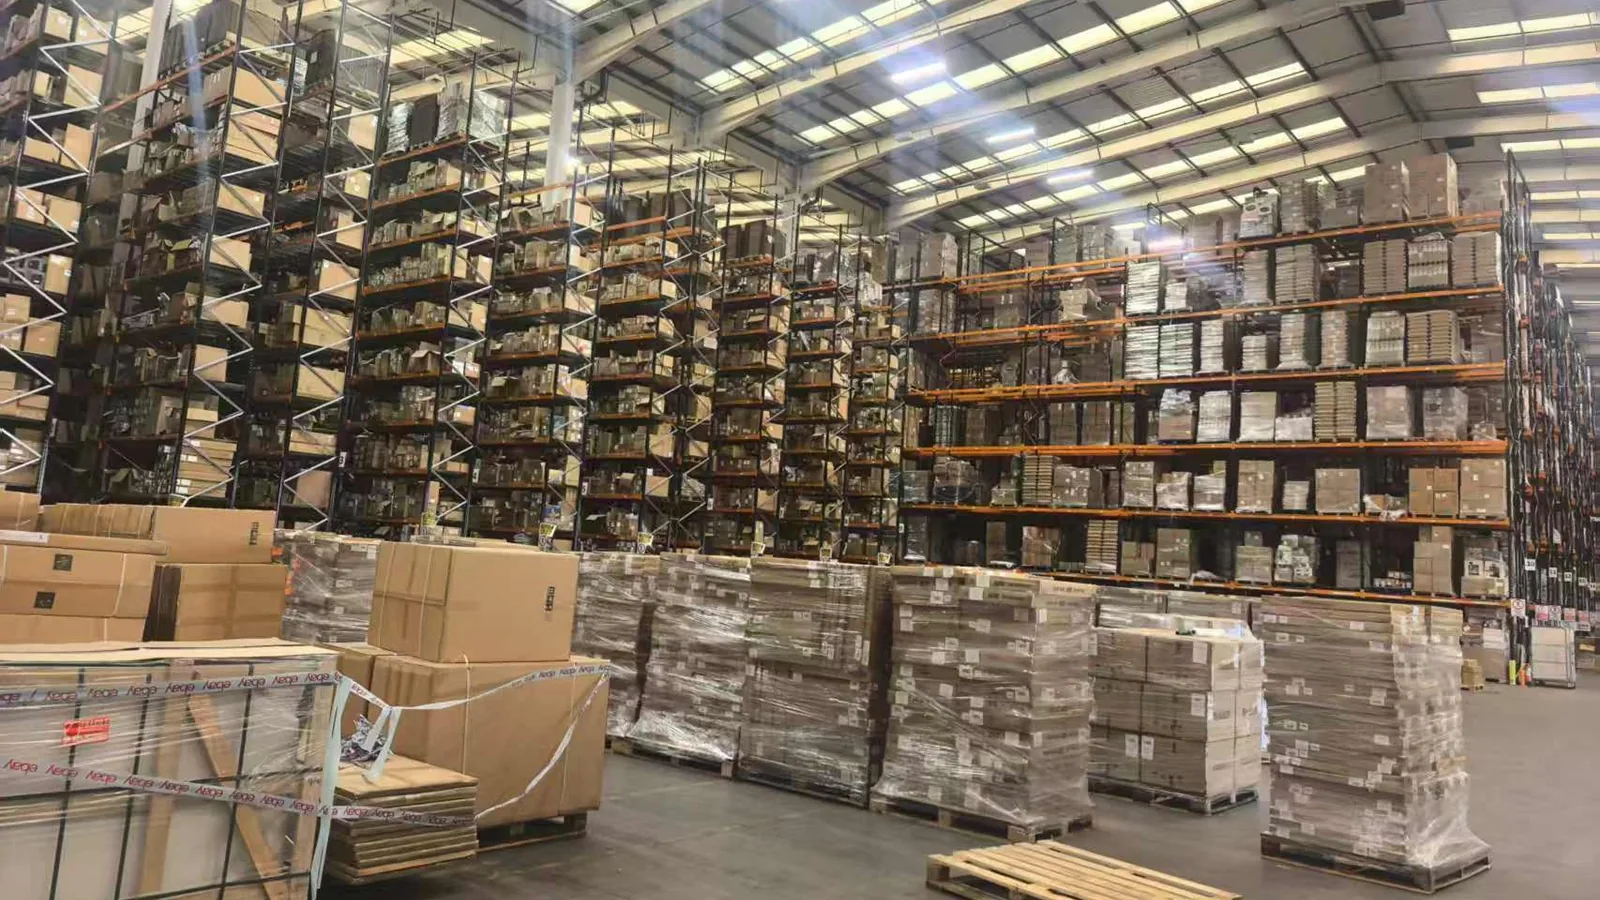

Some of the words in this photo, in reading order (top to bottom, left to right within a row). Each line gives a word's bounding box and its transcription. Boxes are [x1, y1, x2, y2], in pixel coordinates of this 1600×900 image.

[240, 677, 266, 689] ebay
[271, 675, 299, 686] ebay
[305, 672, 329, 683] ebay
[126, 685, 158, 698] ebay
[165, 682, 196, 695] ebay
[203, 680, 231, 692] ebay
[3, 758, 38, 776] ebay
[45, 764, 78, 778] ebay
[85, 770, 118, 784] ebay
[123, 775, 154, 790] ebay
[159, 780, 190, 794] ebay
[195, 785, 223, 800] ebay
[260, 795, 285, 807] ebay
[289, 800, 315, 815] ebay
[343, 807, 368, 817] ebay
